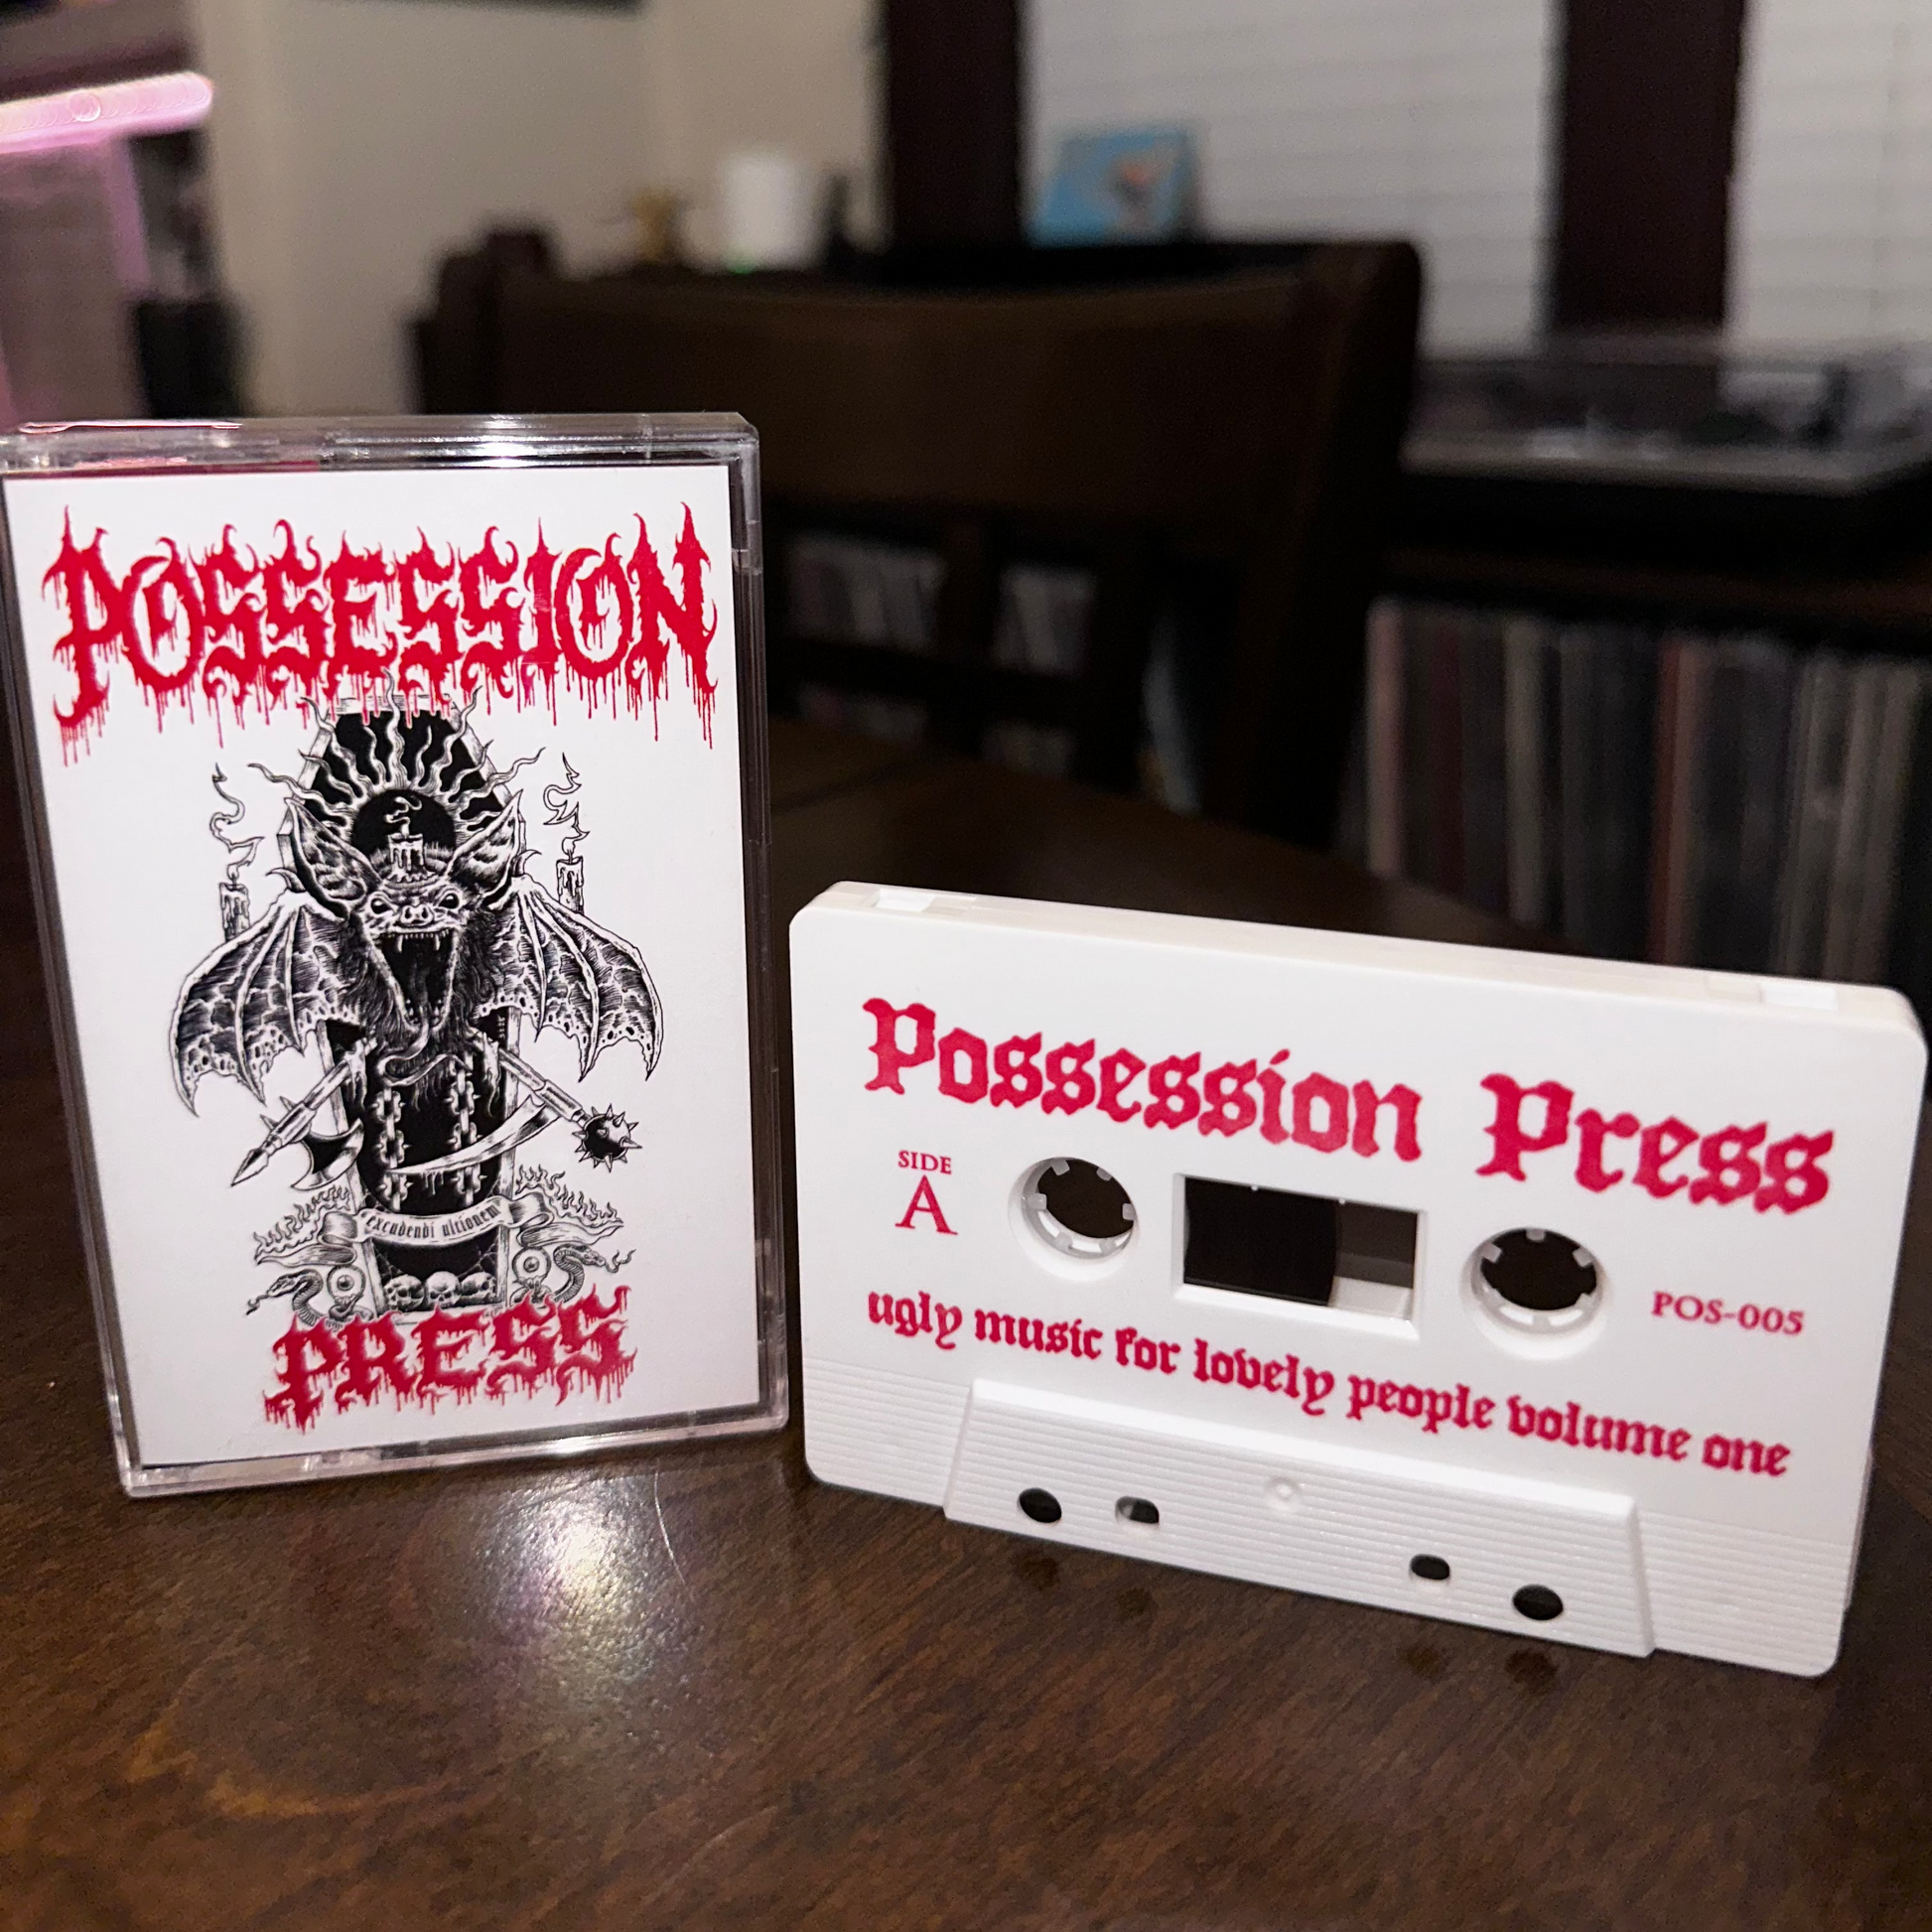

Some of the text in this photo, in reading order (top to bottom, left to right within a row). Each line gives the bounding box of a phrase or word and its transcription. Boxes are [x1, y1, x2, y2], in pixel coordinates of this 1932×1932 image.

[42, 502, 718, 765] POSSESSION
[862, 998, 1834, 1215] Possession Press
[897, 1150, 952, 1174] SIDE
[895, 1175, 957, 1235] A
[264, 1284, 636, 1433] PRESS
[868, 1291, 1791, 1477] ugly music for lovely people volume one
[1652, 1292, 1804, 1335] POS-005
